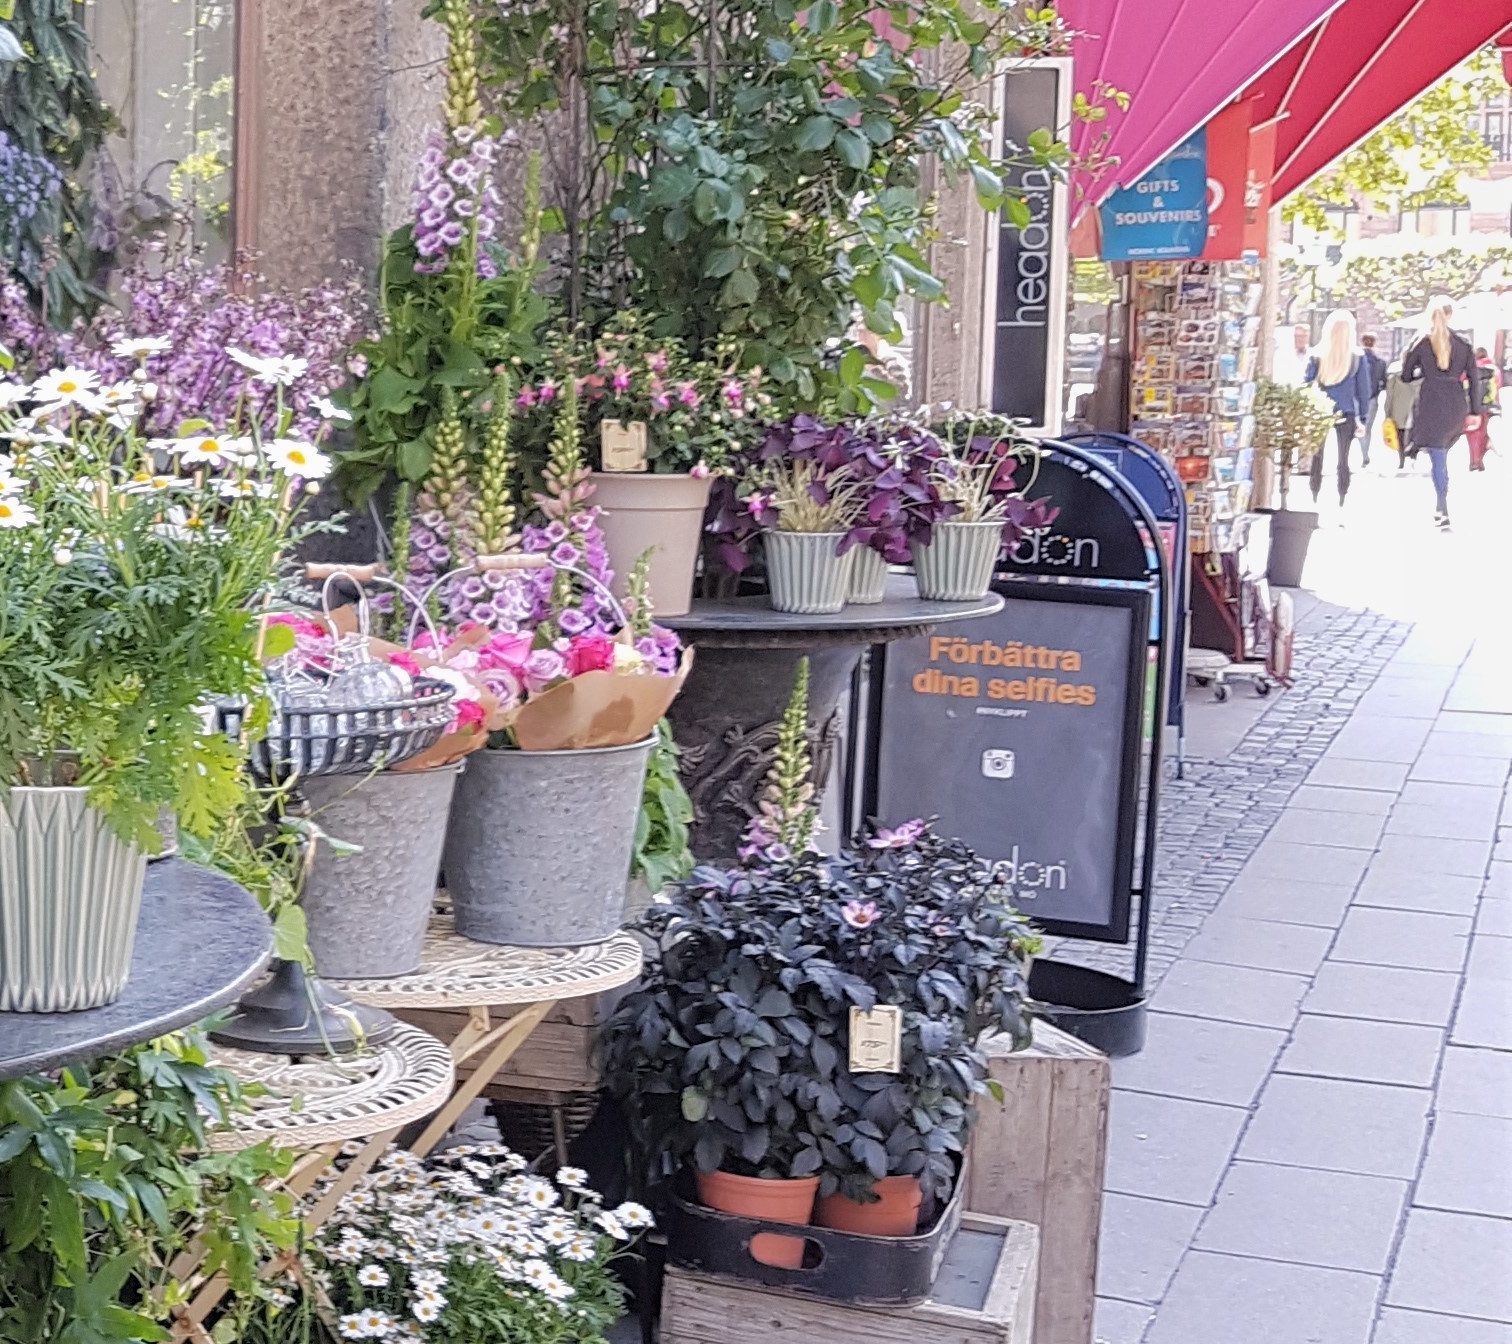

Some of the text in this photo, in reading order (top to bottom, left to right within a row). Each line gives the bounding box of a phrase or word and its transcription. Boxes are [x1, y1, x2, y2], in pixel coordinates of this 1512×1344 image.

[1137, 179, 1180, 194] GIFTS
[1152, 195, 1165, 208] &
[1115, 209, 1202, 226] SOUVENIRS
[996, 168, 1053, 327] headon
[929, 635, 1082, 672] Förbättra
[912, 668, 1097, 706] dina selfies
